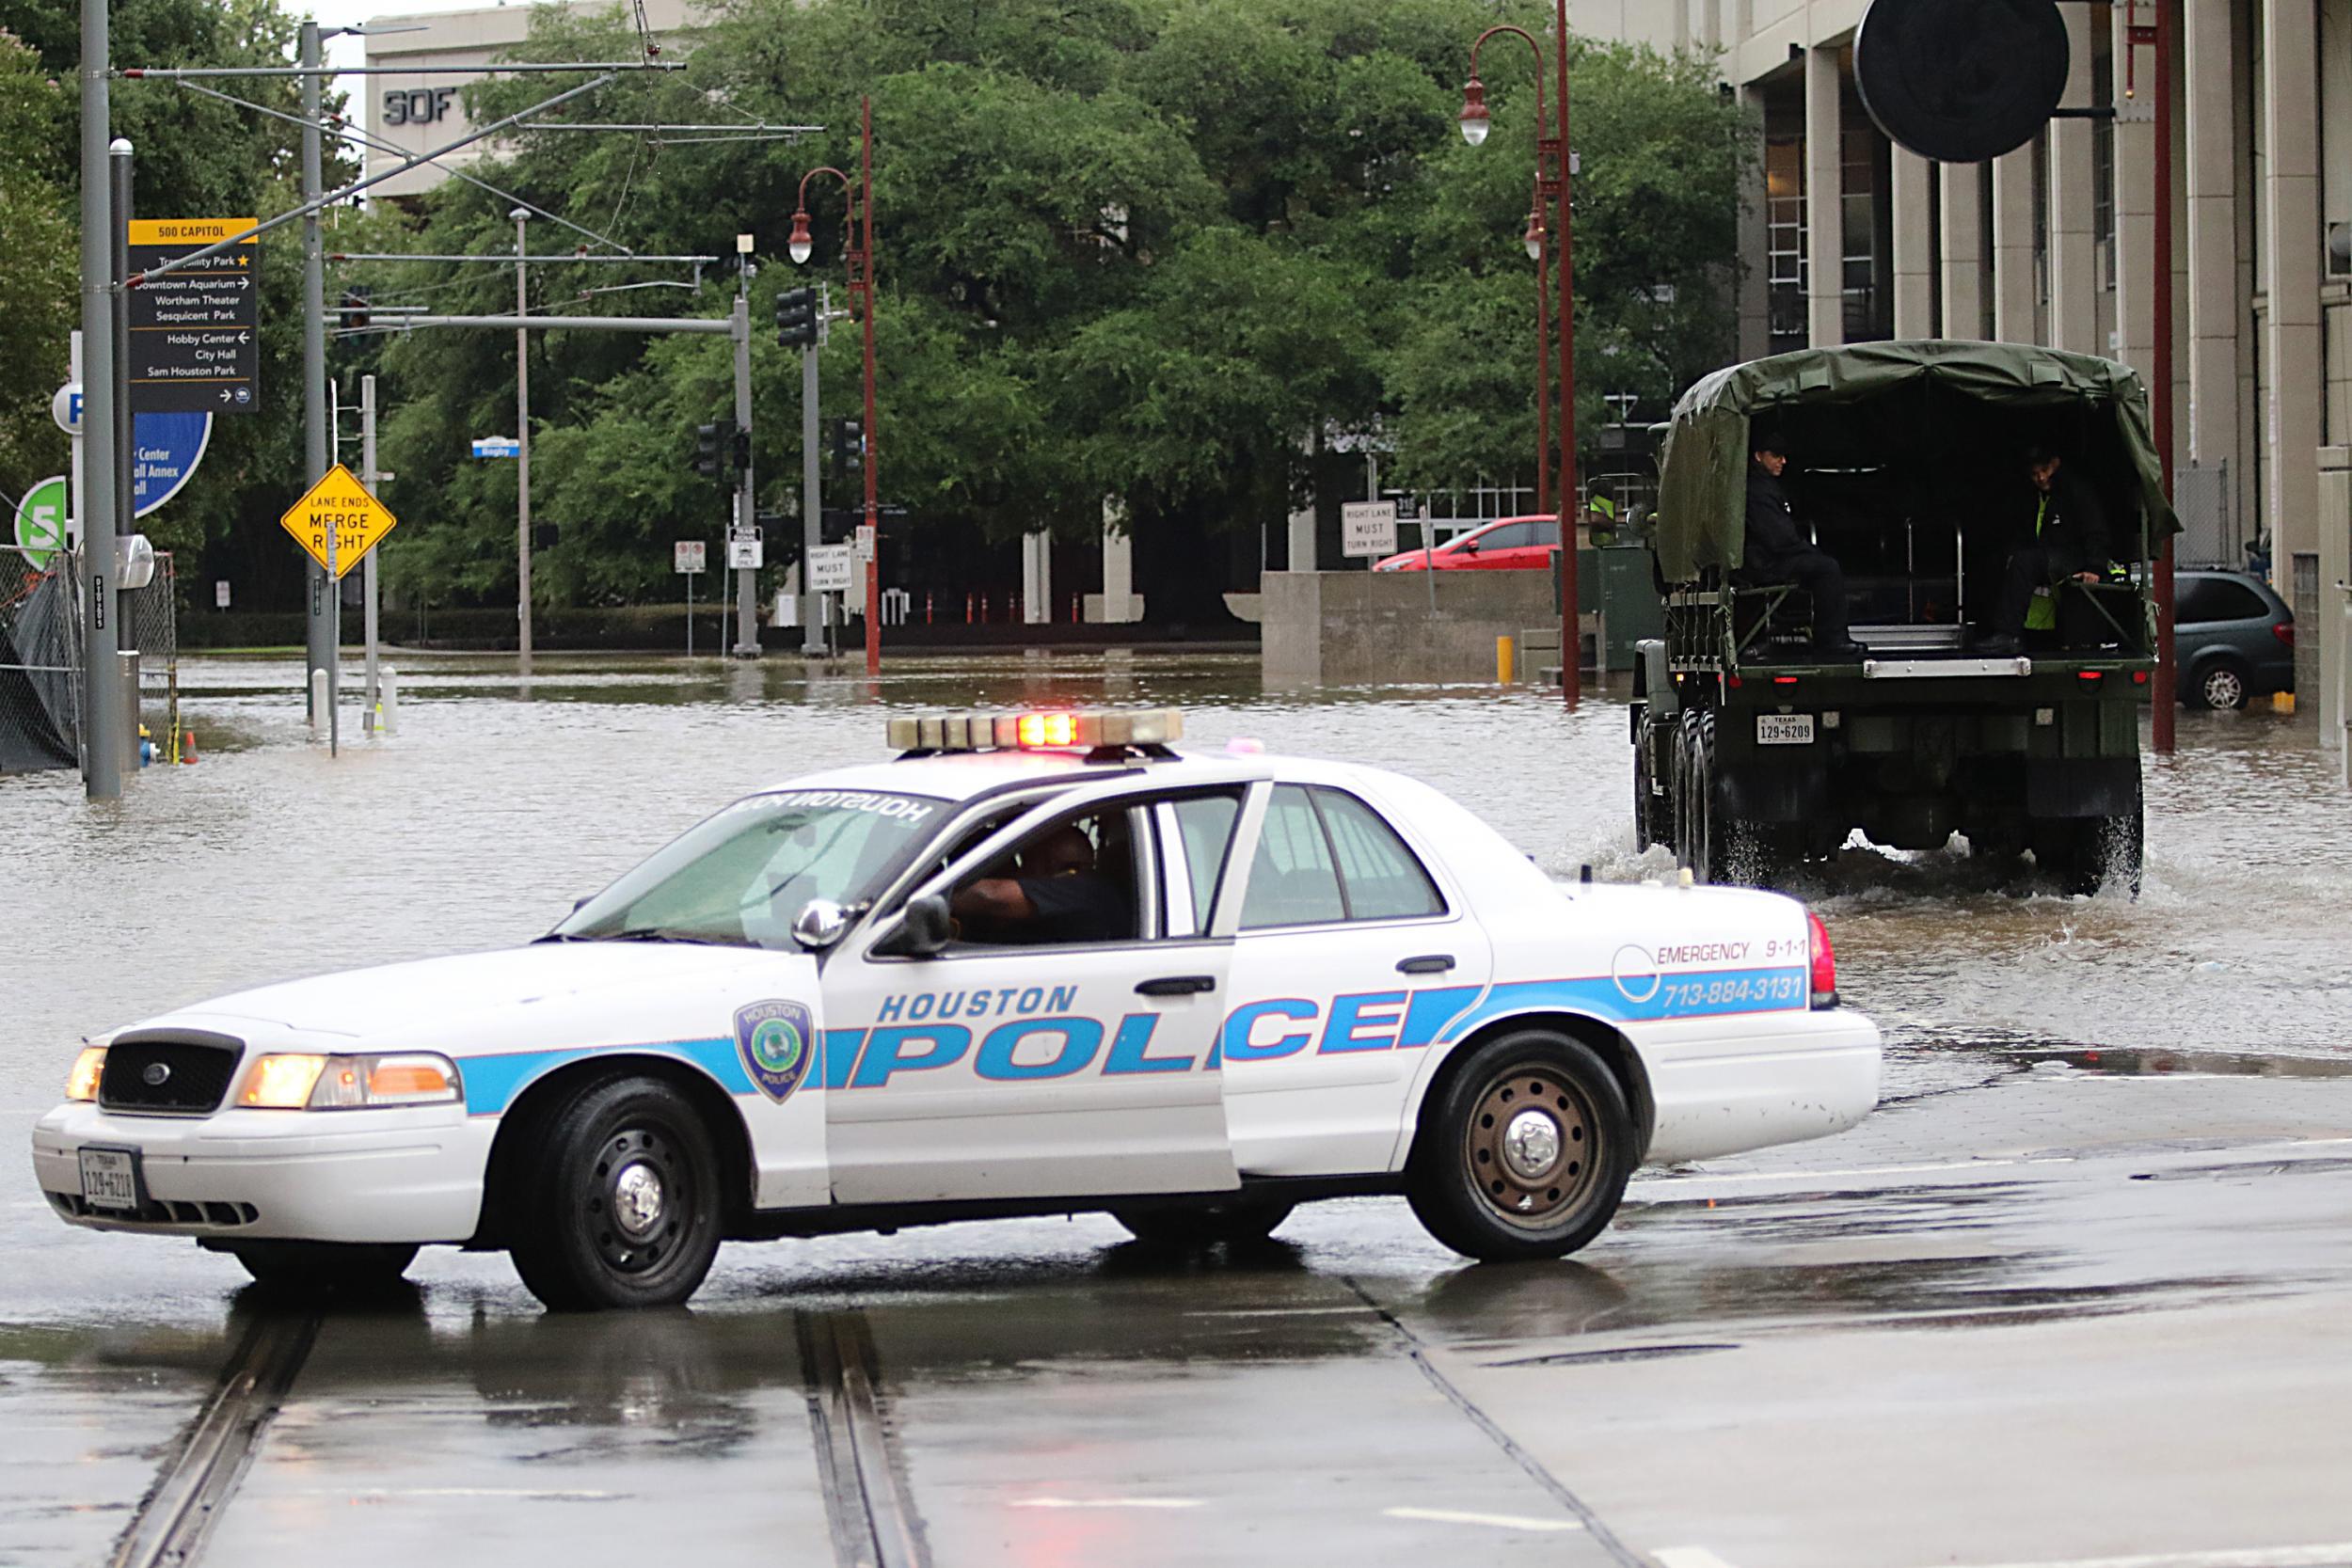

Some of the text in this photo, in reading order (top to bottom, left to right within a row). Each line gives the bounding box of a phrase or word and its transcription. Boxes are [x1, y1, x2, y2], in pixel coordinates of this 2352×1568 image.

[158, 225, 226, 238] 500 CAPITOL
[214, 256, 235, 266] Park
[189, 279, 236, 291] Aquarium
[155, 293, 240, 307] Wortham Theater
[156, 310, 236, 323] Sesquicent Park
[167, 333, 235, 346] Hobby Center
[195, 349, 237, 362] City Hall
[148, 365, 236, 377] Sam Houston Park
[138, 446, 169, 461] Center
[134, 462, 179, 478] all Annex
[134, 480, 146, 495] all
[310, 497, 369, 508] LANE ENDS
[1346, 510, 1369, 519] RIGHT
[1372, 509, 1392, 518] LANE
[29, 505, 58, 546] 5
[310, 514, 369, 529] MERGE
[1356, 524, 1384, 534] MUST
[312, 534, 365, 549] RGHT
[1371, 539, 1392, 547] RIGHT
[817, 563, 844, 573] MUST
[1658, 942, 1751, 965] EMERGENCY
[1662, 975, 1803, 1008] 713-884-3131
[876, 985, 1079, 1023] HOUSTON
[744, 1005, 801, 1024] HOUSTON
